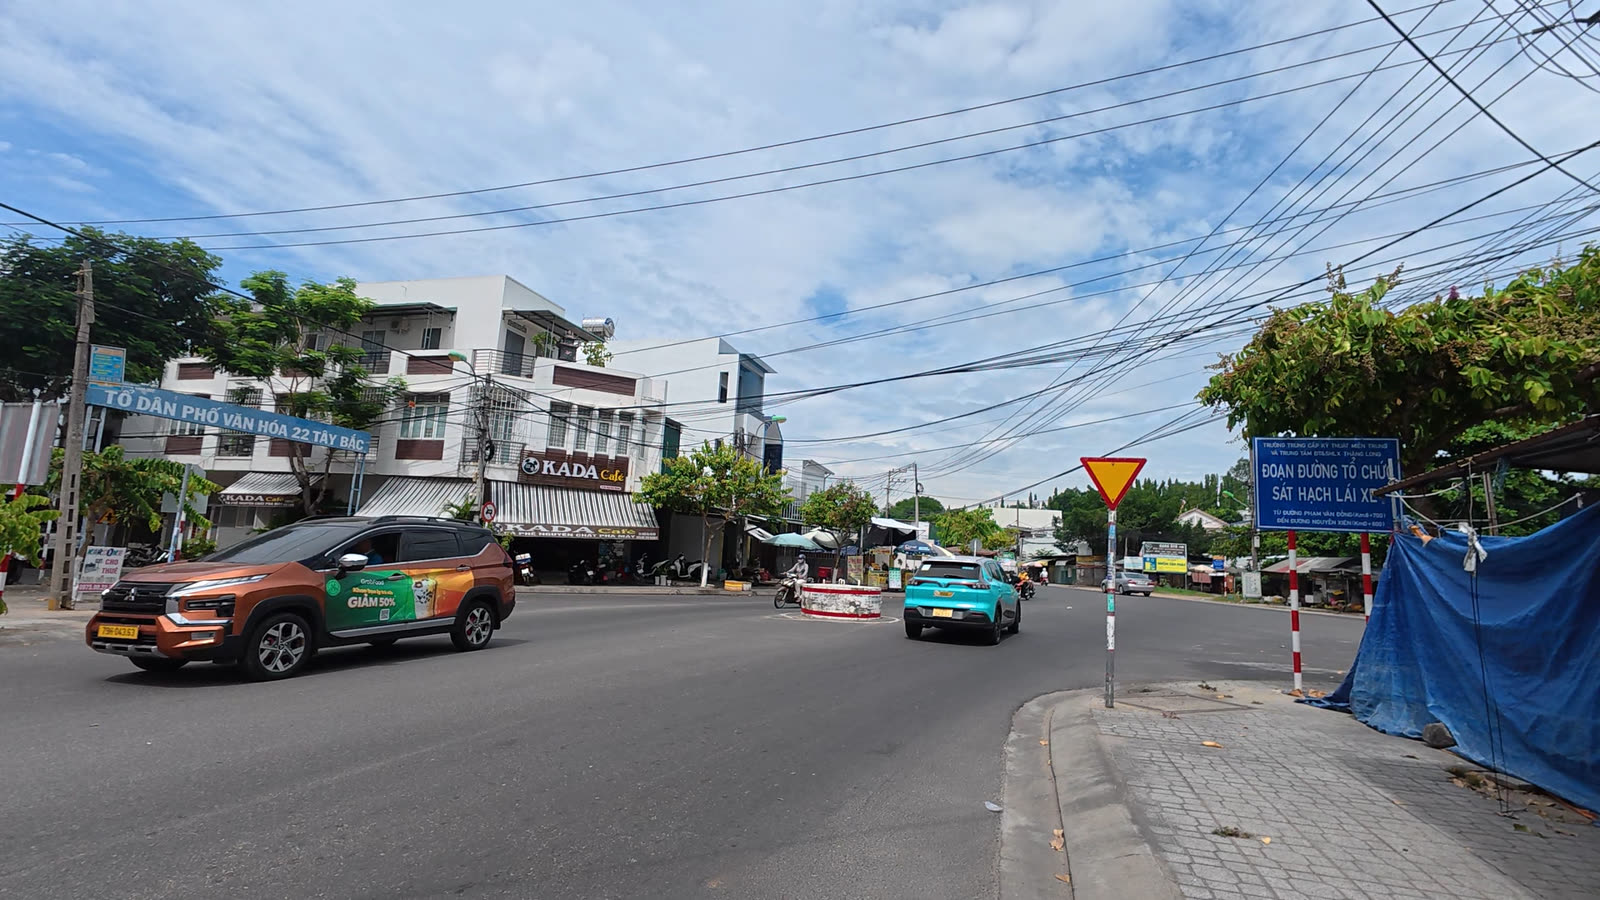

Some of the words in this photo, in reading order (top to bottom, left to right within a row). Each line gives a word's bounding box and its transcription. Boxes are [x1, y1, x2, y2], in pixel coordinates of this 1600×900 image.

[104, 388, 135, 408] TỔ
[136, 396, 177, 417] DÂN
[181, 405, 221, 424] PHỐ
[223, 412, 254, 431] VĂN
[257, 419, 288, 437] HÓA
[291, 427, 310, 441] 22
[313, 430, 337, 446] TÂY
[340, 433, 364, 450] BẮC
[541, 460, 599, 479] KADA
[600, 469, 624, 482] Café
[1262, 463, 1294, 481] ĐOẠN
[1298, 459, 1338, 479] ĐƯỜNG
[1341, 457, 1357, 479] TỔ
[226, 494, 264, 502] KADA
[1272, 481, 1293, 501] SÁT
[1298, 486, 1332, 504] HẠCH
[1336, 483, 1357, 502] LÁI
[1361, 488, 1378, 503] XE
[504, 523, 594, 534] KADA
[347, 593, 378, 609] GIẢM
[379, 598, 396, 608] 50%
